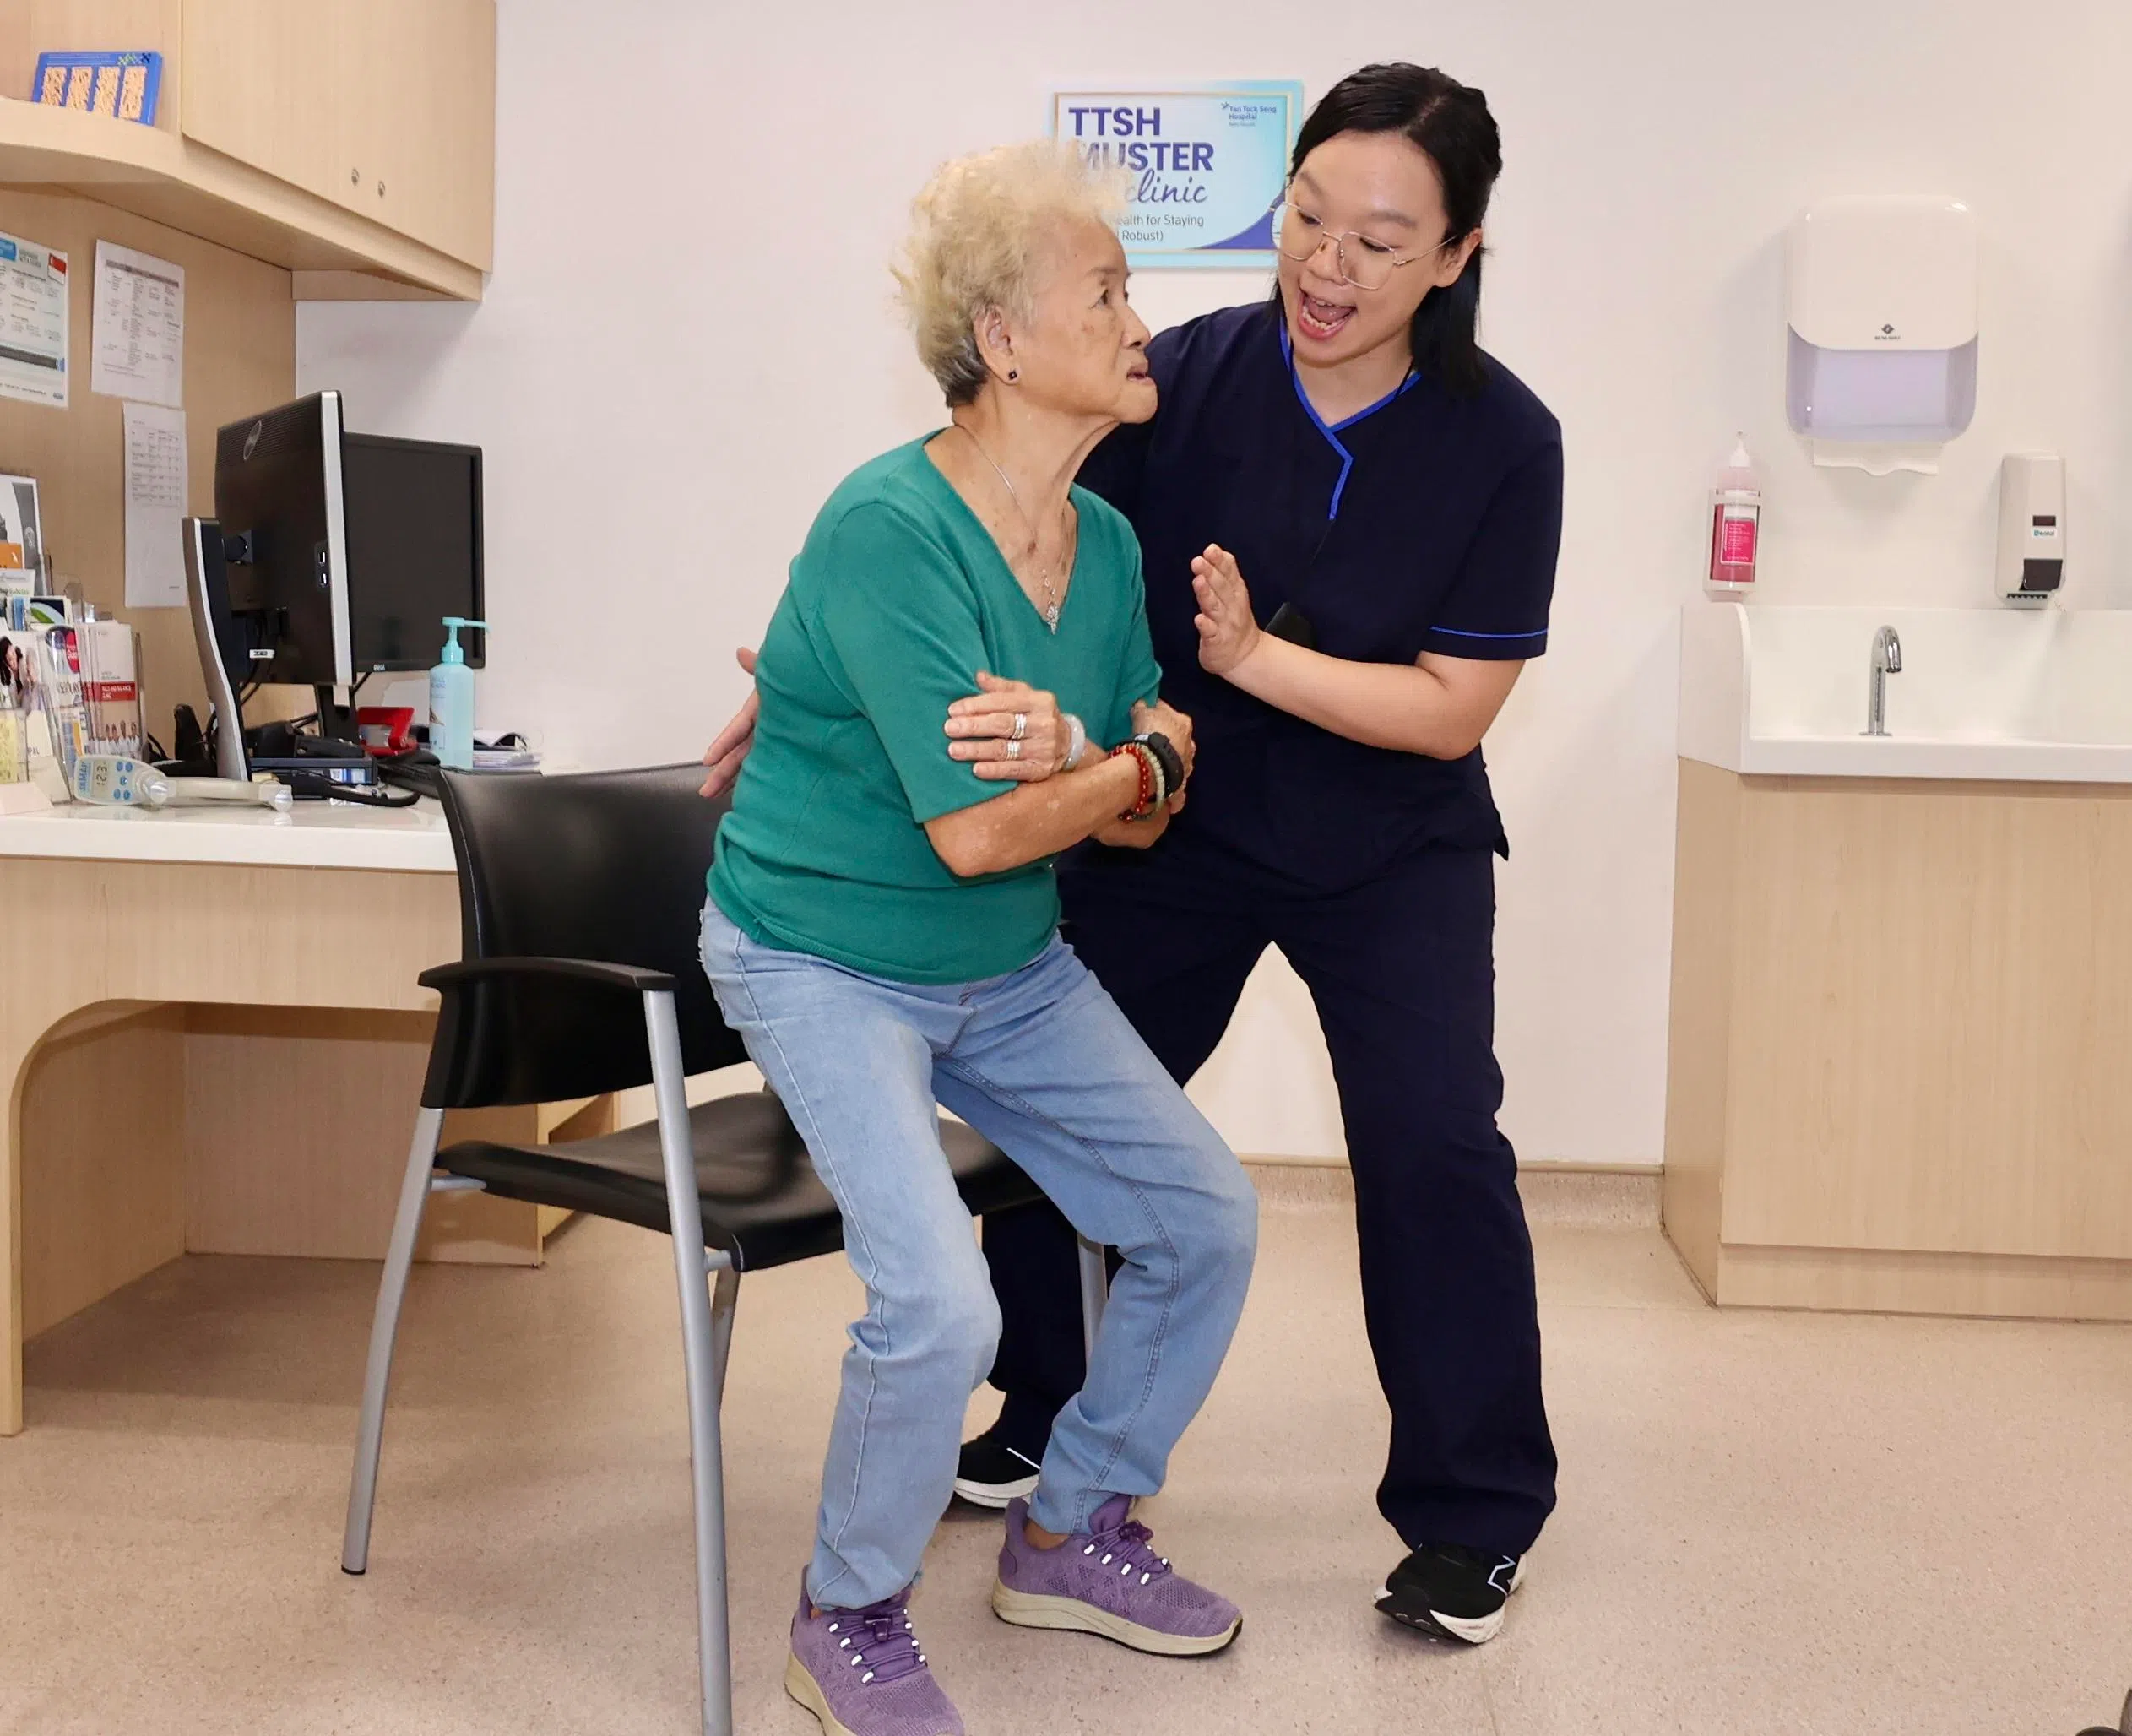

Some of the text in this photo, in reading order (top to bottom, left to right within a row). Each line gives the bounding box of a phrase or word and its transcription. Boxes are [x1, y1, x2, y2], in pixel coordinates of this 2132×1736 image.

[1068, 107, 1161, 136] TTSH
[1125, 168, 1208, 203] clinic
[1116, 214, 1204, 227] ealth for Staying
[1122, 229, 1164, 241] Robust)
